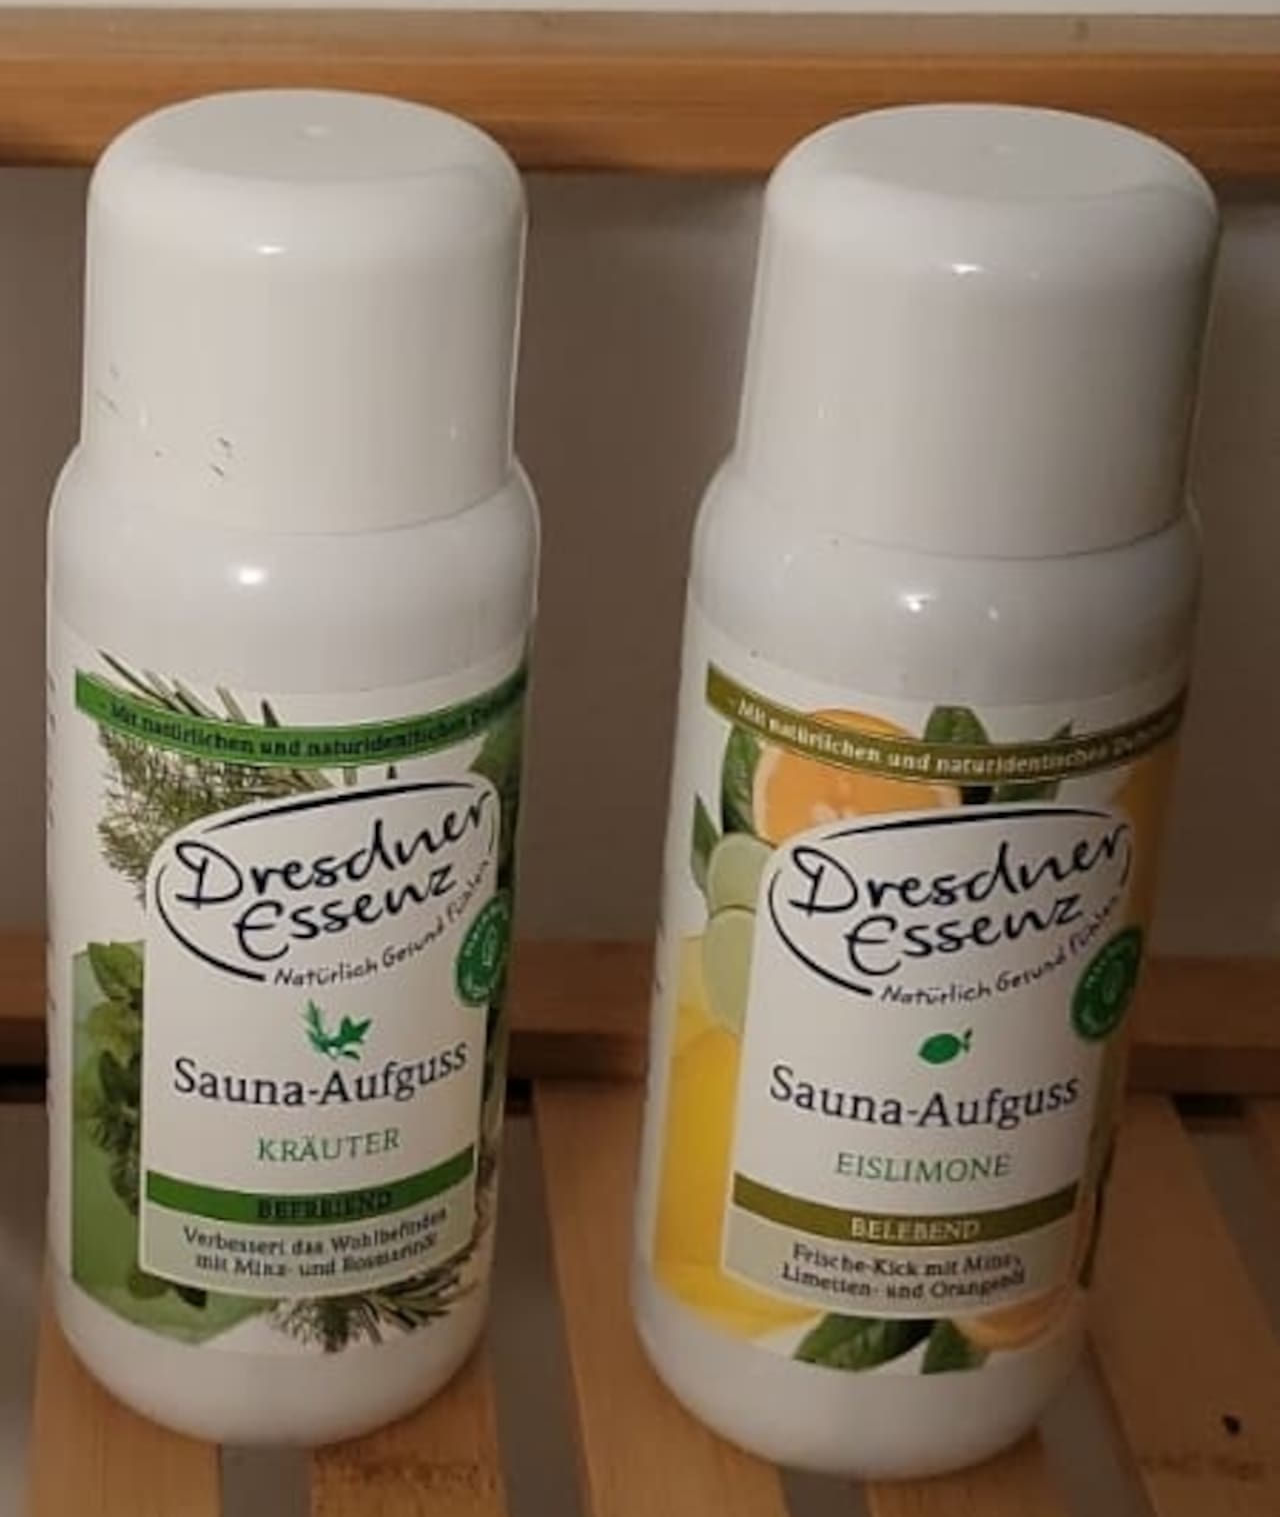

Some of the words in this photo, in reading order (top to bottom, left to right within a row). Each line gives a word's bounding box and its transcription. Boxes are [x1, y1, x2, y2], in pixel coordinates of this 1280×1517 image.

[260, 737, 302, 757] und
[770, 718, 882, 763] natürlichen
[887, 752, 932, 773] und
[173, 787, 493, 910] Dresdner
[788, 822, 1129, 918] Dresdner
[232, 862, 457, 962] Essenz
[844, 893, 1083, 977] Essenz
[273, 956, 378, 988] Natürlich
[381, 915, 446, 968] Gesund
[880, 982, 991, 1006] Natürlich
[995, 947, 1068, 993] Gesund
[173, 1041, 469, 1107] Sauna-Aufguss
[769, 1064, 1080, 1130] Sauna-Aufguss
[256, 1126, 401, 1163] KRÄUTER
[835, 1151, 1013, 1183] EISLIMONE
[182, 1225, 285, 1256] Verbessert
[291, 1238, 325, 1257] das
[850, 1216, 982, 1242] BELEBEND
[195, 1251, 228, 1273] mit
[298, 1259, 337, 1278] und
[791, 1241, 917, 1277] Frische-Kick
[924, 1259, 959, 1277] mit
[885, 1281, 924, 1300] und
